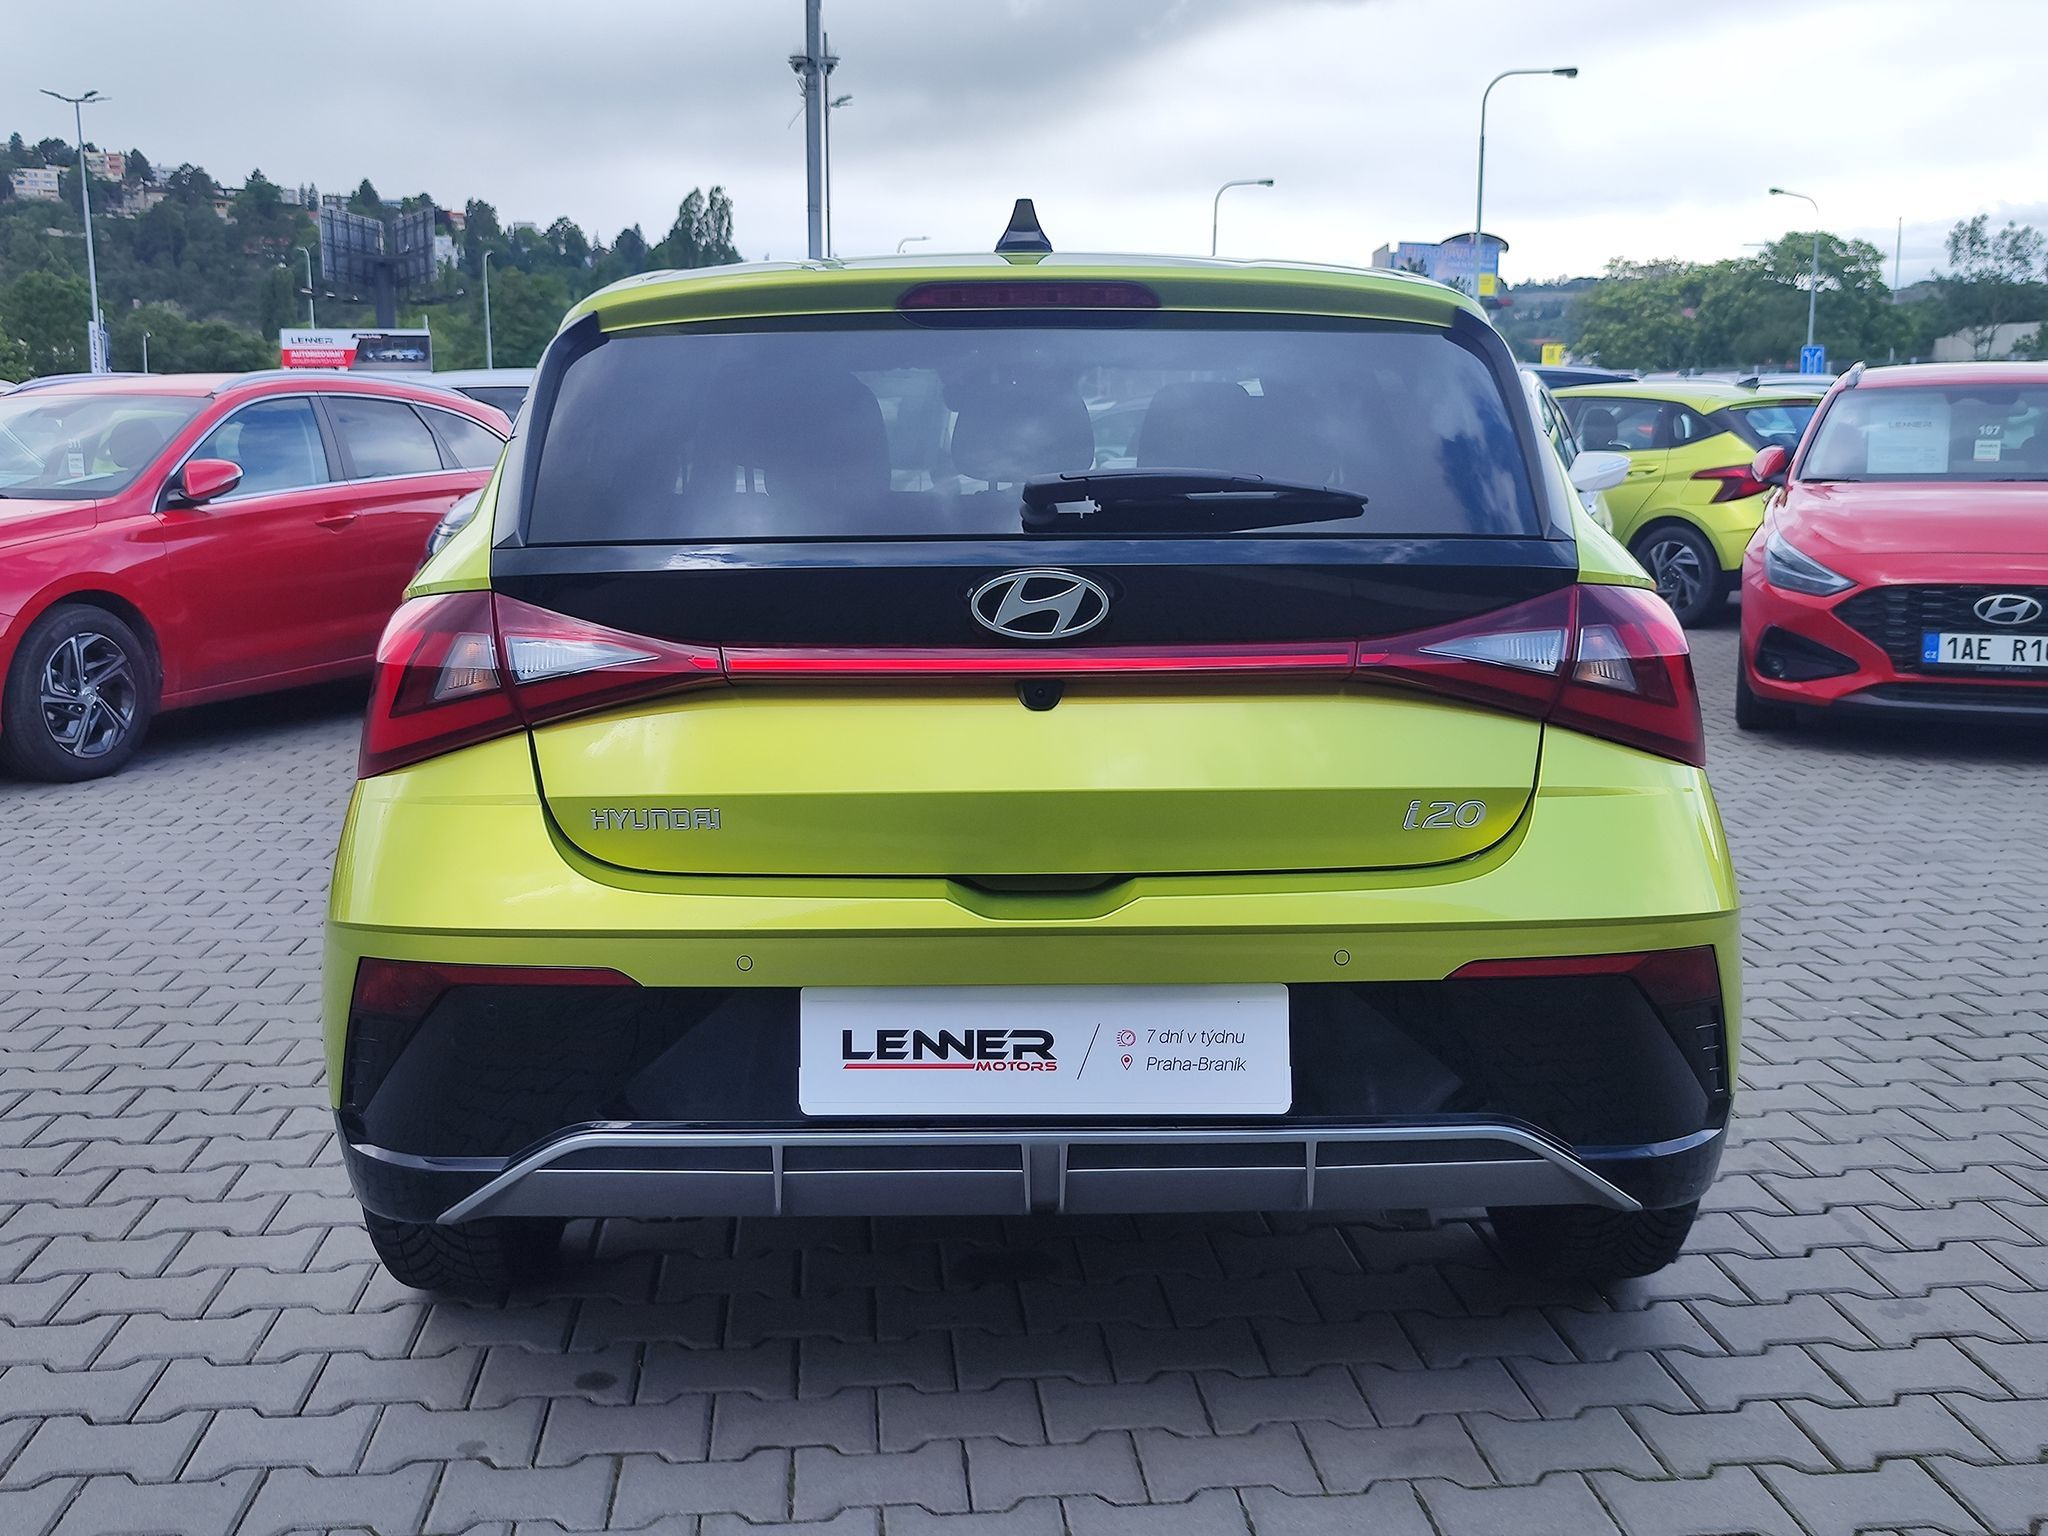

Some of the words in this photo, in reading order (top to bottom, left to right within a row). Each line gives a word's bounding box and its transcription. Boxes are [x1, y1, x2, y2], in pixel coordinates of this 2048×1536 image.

[1978, 425, 2000, 435] 107
[1924, 650, 1937, 658] CZ
[1947, 637, 1992, 660] 1AE
[2012, 639, 2048, 661] R1
[590, 808, 721, 830] HYUNDAI
[1403, 800, 1487, 830] i20
[842, 1029, 1057, 1060] LENNER
[1147, 1029, 1156, 1043] 7
[1159, 1029, 1184, 1043] dní
[1187, 1032, 1197, 1043] v
[1201, 1028, 1245, 1047] týdnu
[975, 1061, 1057, 1071] MOTORS
[1146, 1057, 1247, 1071] Praha-Braník
